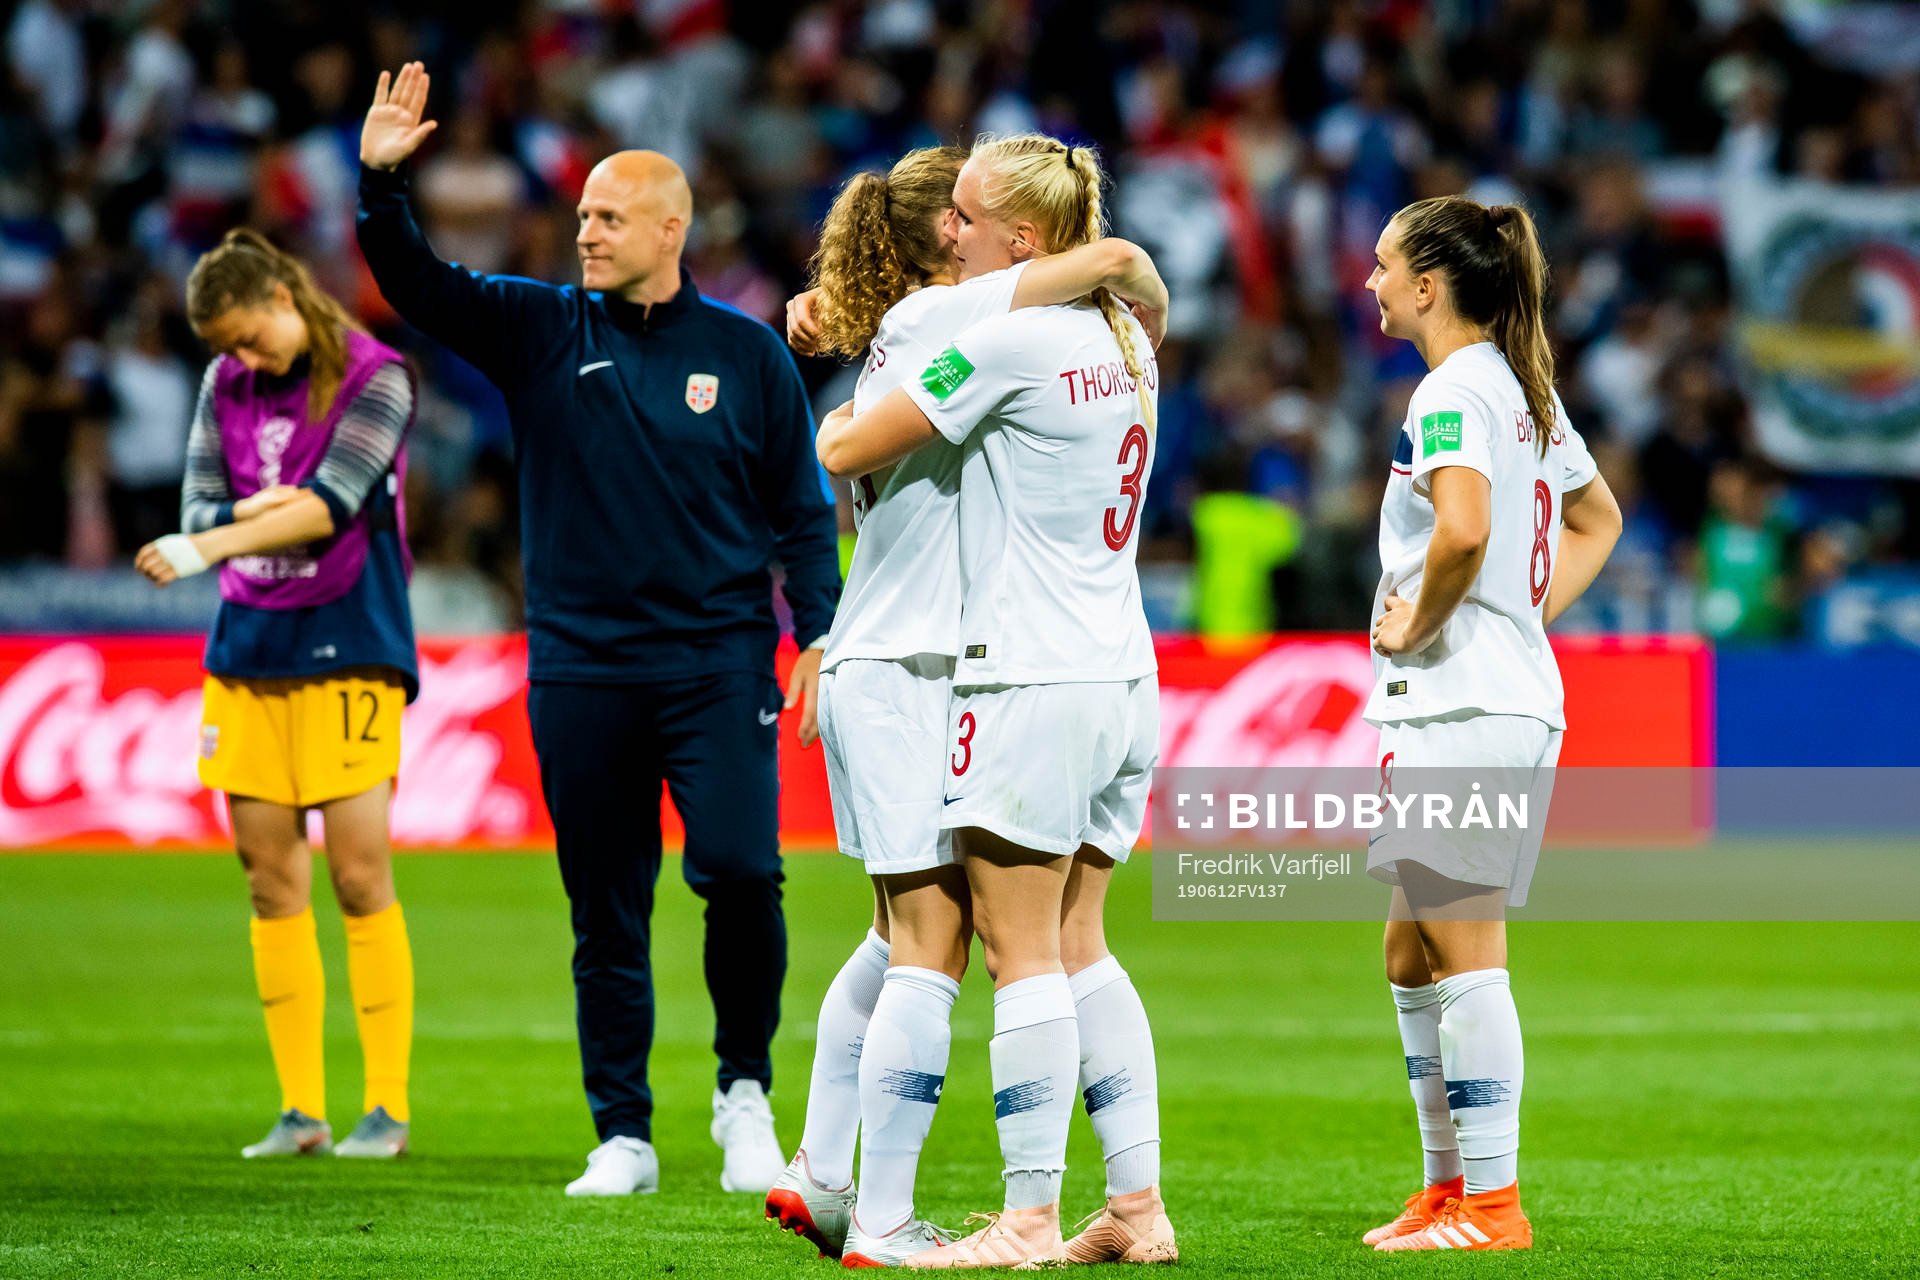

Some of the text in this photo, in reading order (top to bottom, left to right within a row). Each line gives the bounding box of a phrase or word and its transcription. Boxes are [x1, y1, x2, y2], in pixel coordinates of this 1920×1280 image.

[1103, 423, 1149, 552] 3
[1530, 479, 1552, 607] 8
[338, 691, 379, 742] 12
[952, 711, 976, 776] 3
